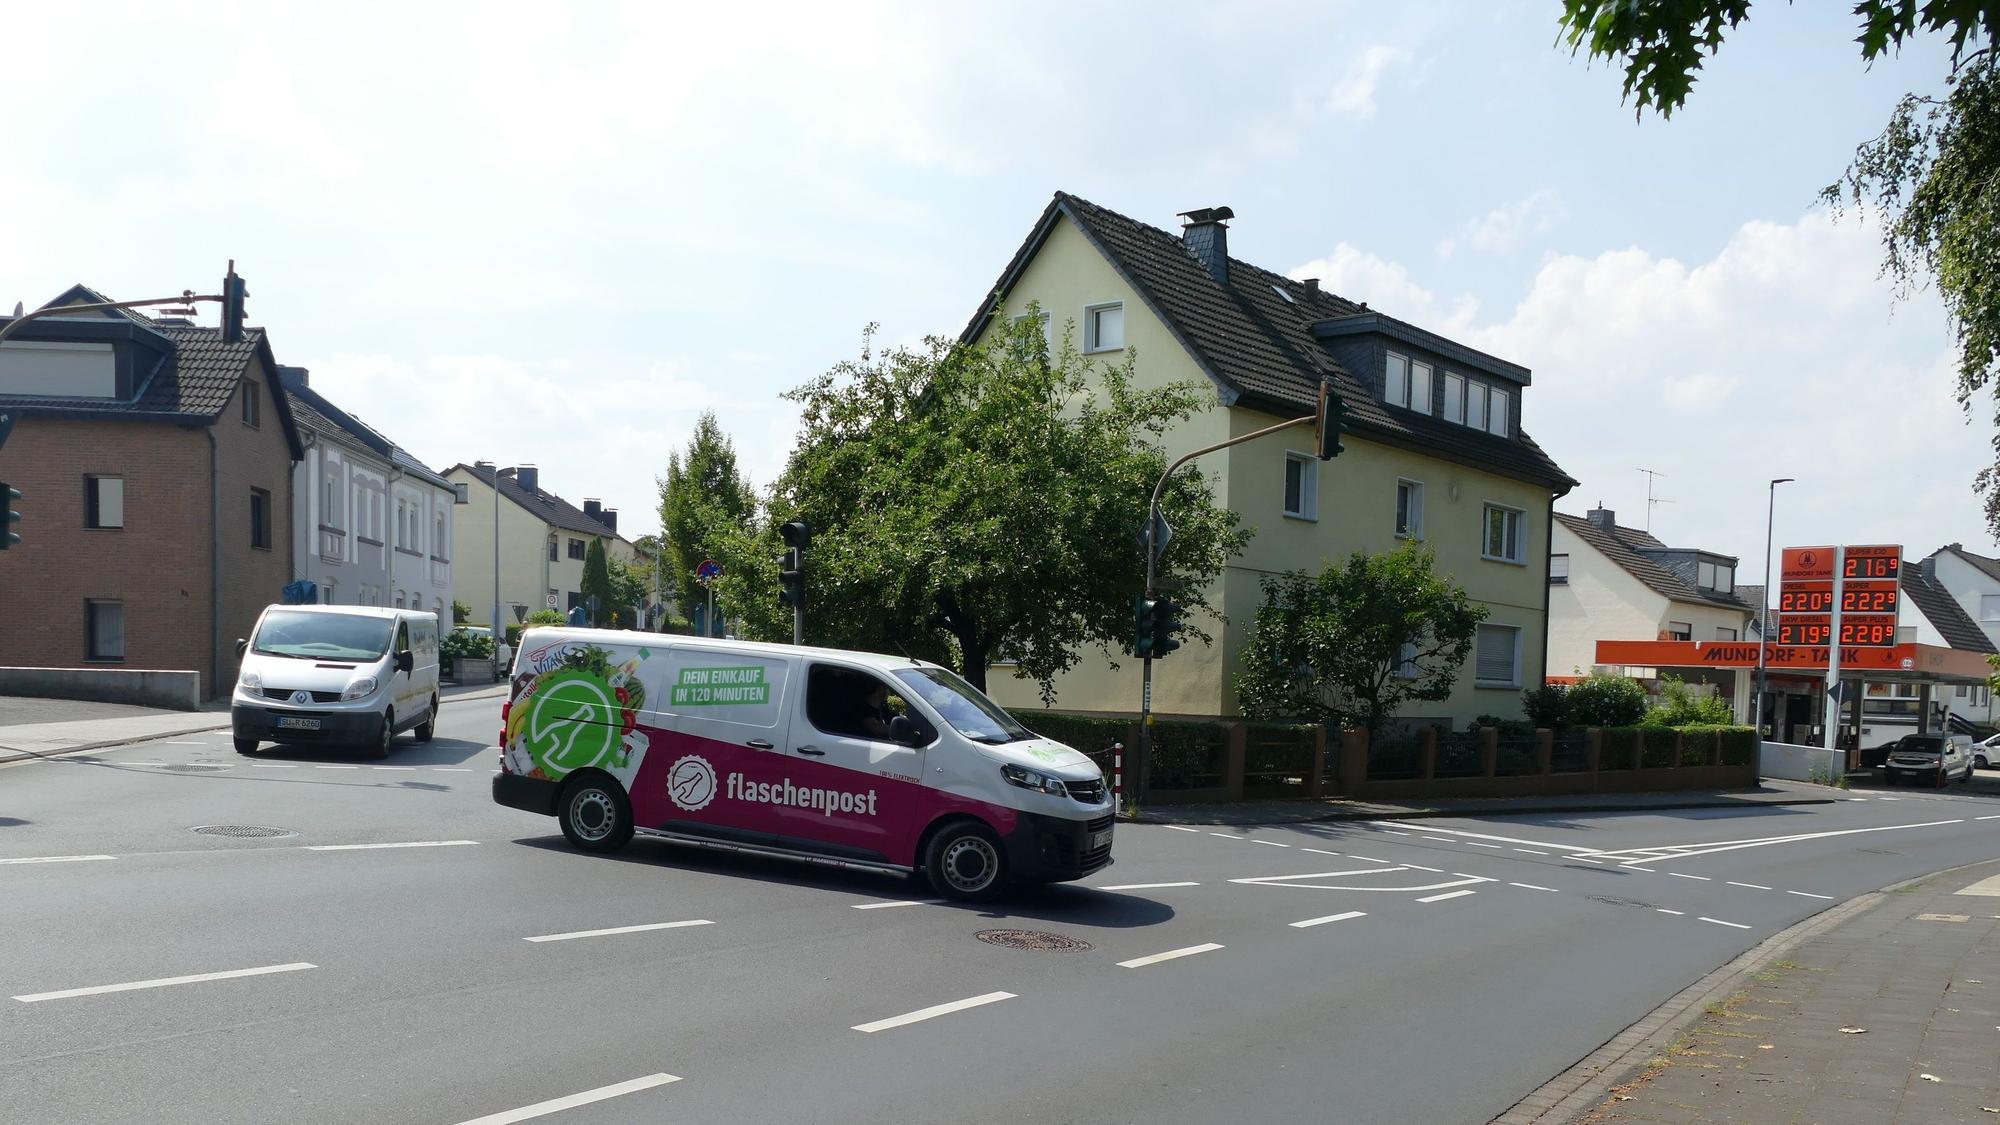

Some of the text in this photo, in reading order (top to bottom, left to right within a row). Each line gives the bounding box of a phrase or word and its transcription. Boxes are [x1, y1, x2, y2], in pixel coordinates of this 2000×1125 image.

[1704, 647, 1796, 662] MUNDORF
[683, 669, 761, 684] DEIN EINKAUF
[675, 686, 765, 702] IN 120 MINUTEN
[727, 772, 877, 816] flaschenpost
